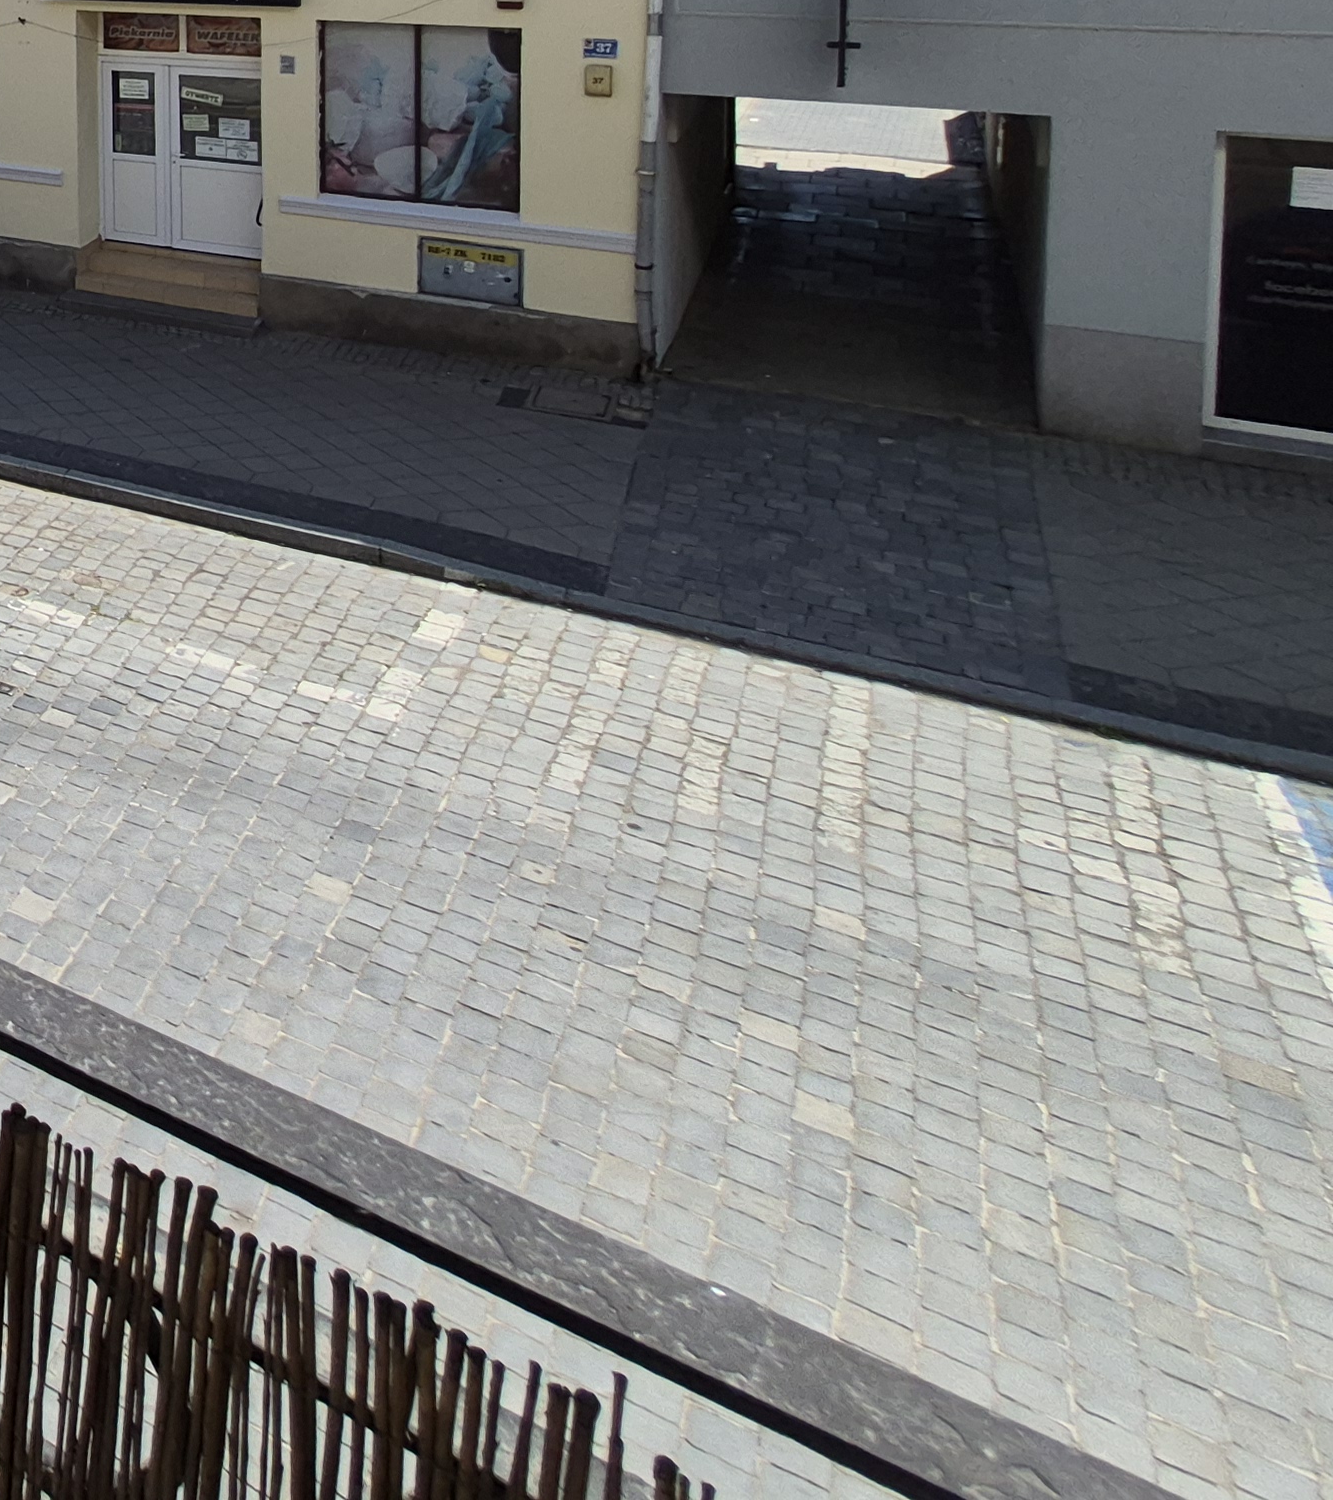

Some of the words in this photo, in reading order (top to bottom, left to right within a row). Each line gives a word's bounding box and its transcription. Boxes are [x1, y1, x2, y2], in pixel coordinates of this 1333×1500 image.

[109, 26, 175, 39] Piekarnia
[197, 30, 261, 42] WAFELEK
[595, 43, 612, 53] 37
[592, 77, 604, 85] 37
